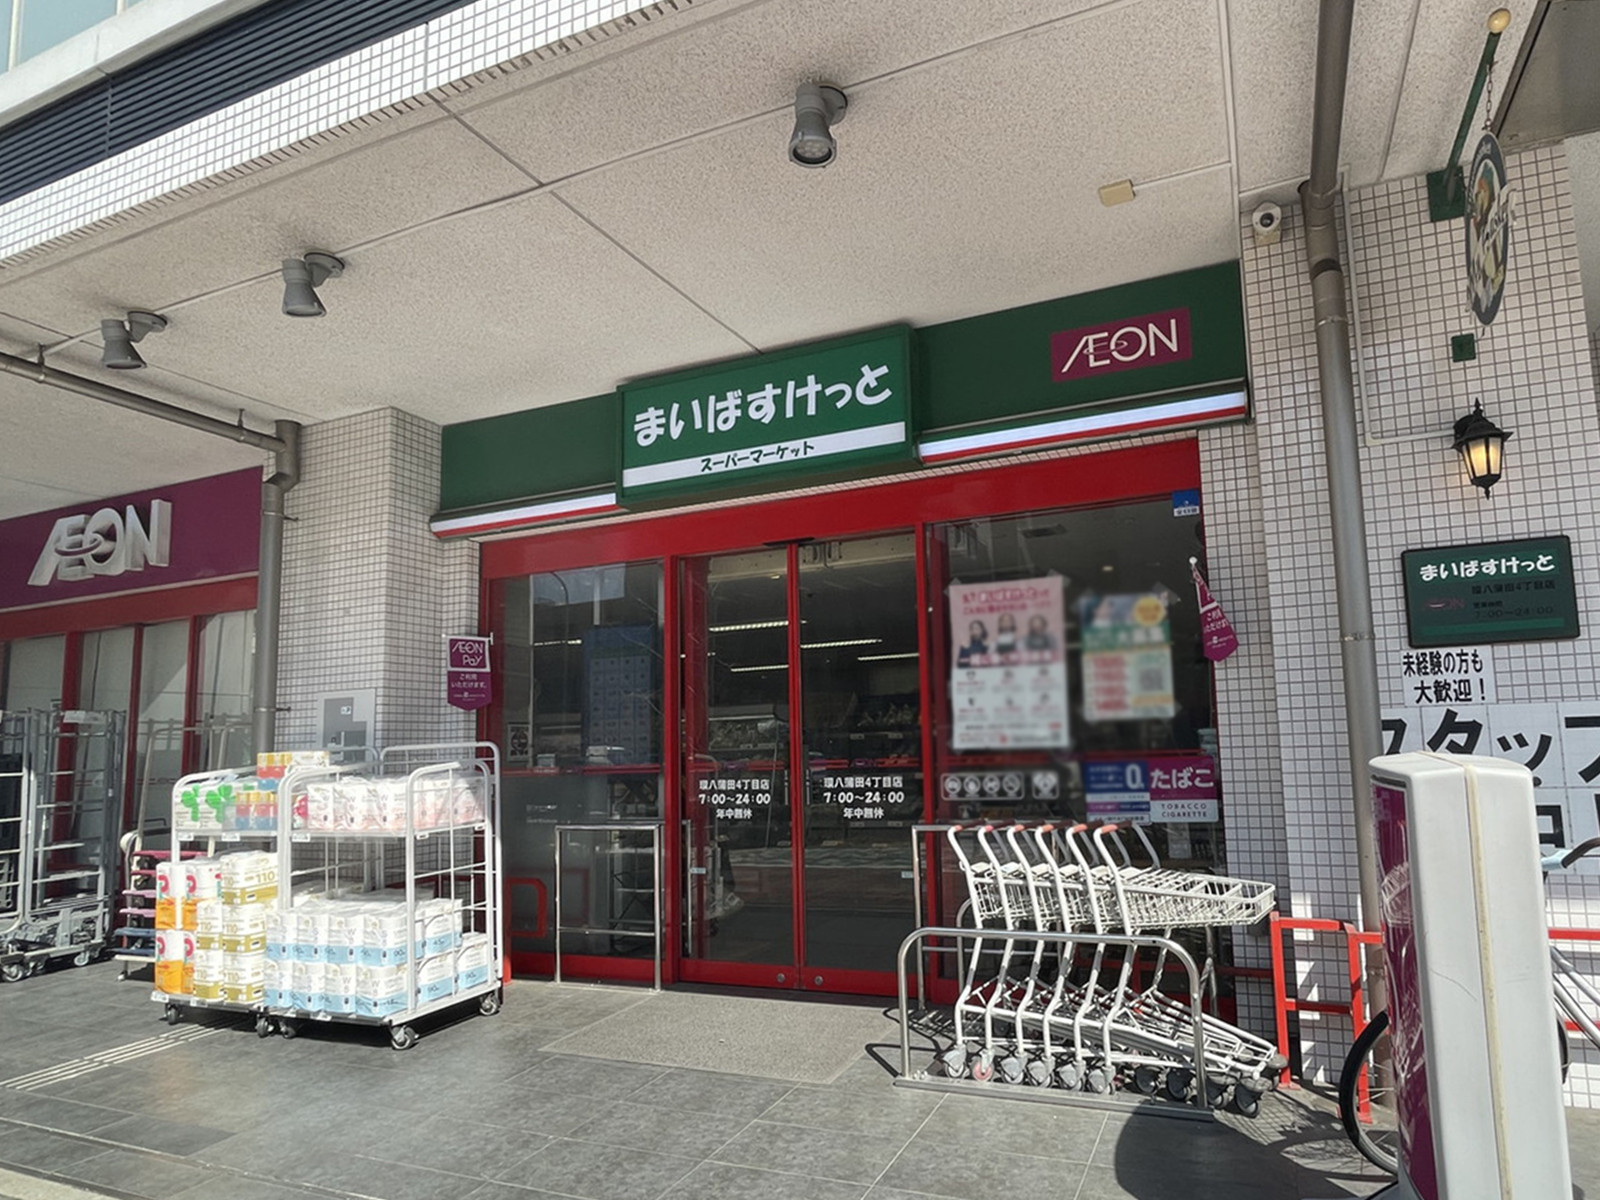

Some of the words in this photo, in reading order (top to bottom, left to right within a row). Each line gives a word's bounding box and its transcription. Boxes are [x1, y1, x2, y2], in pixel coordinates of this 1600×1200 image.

[633, 364, 892, 448] まいばすけっと
[700, 441, 815, 472] スーパーマーケット
[1419, 554, 1555, 582] まいばすけっと
[1403, 649, 1483, 677] 未経験の方も
[1149, 766, 1214, 789] たばこ
[716, 808, 753, 819] 年中無休
[843, 806, 884, 819] 年中無休
